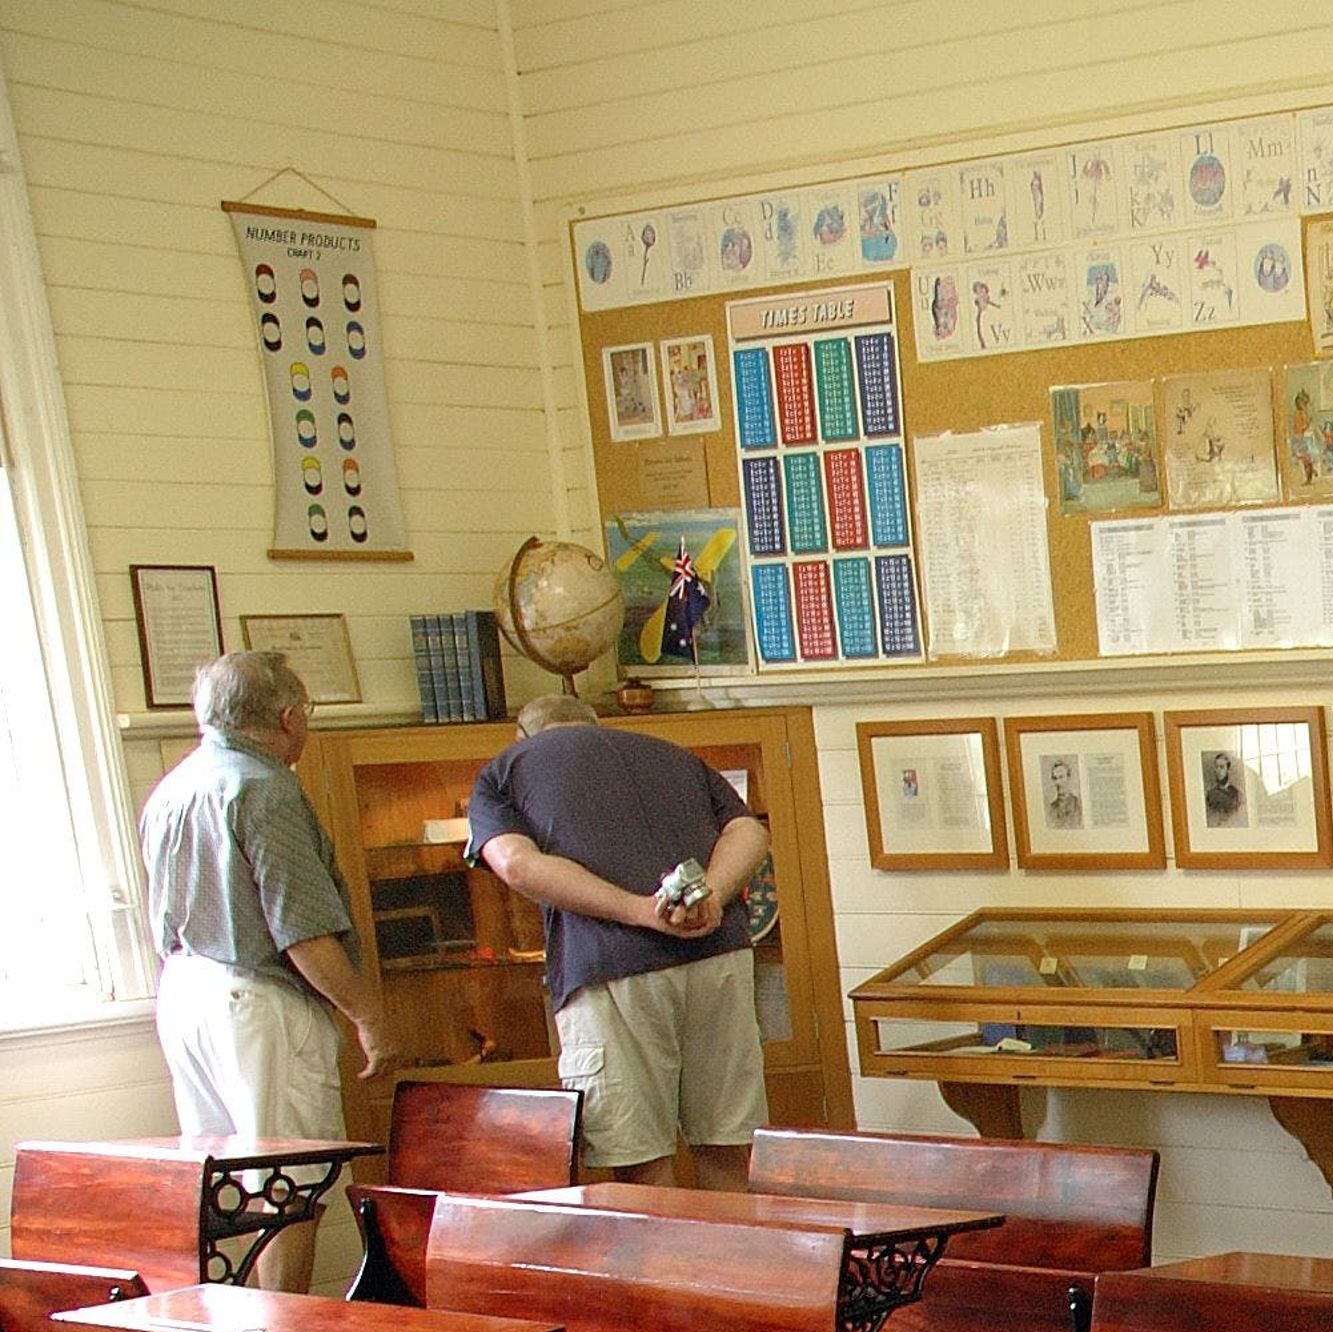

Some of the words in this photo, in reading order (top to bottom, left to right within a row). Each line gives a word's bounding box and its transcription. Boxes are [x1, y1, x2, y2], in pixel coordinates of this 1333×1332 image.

[245, 226, 298, 245] NUMBER
[299, 232, 361, 252] PRODUCTS
[758, 305, 809, 330] TIMES
[812, 300, 855, 324] TABLE
